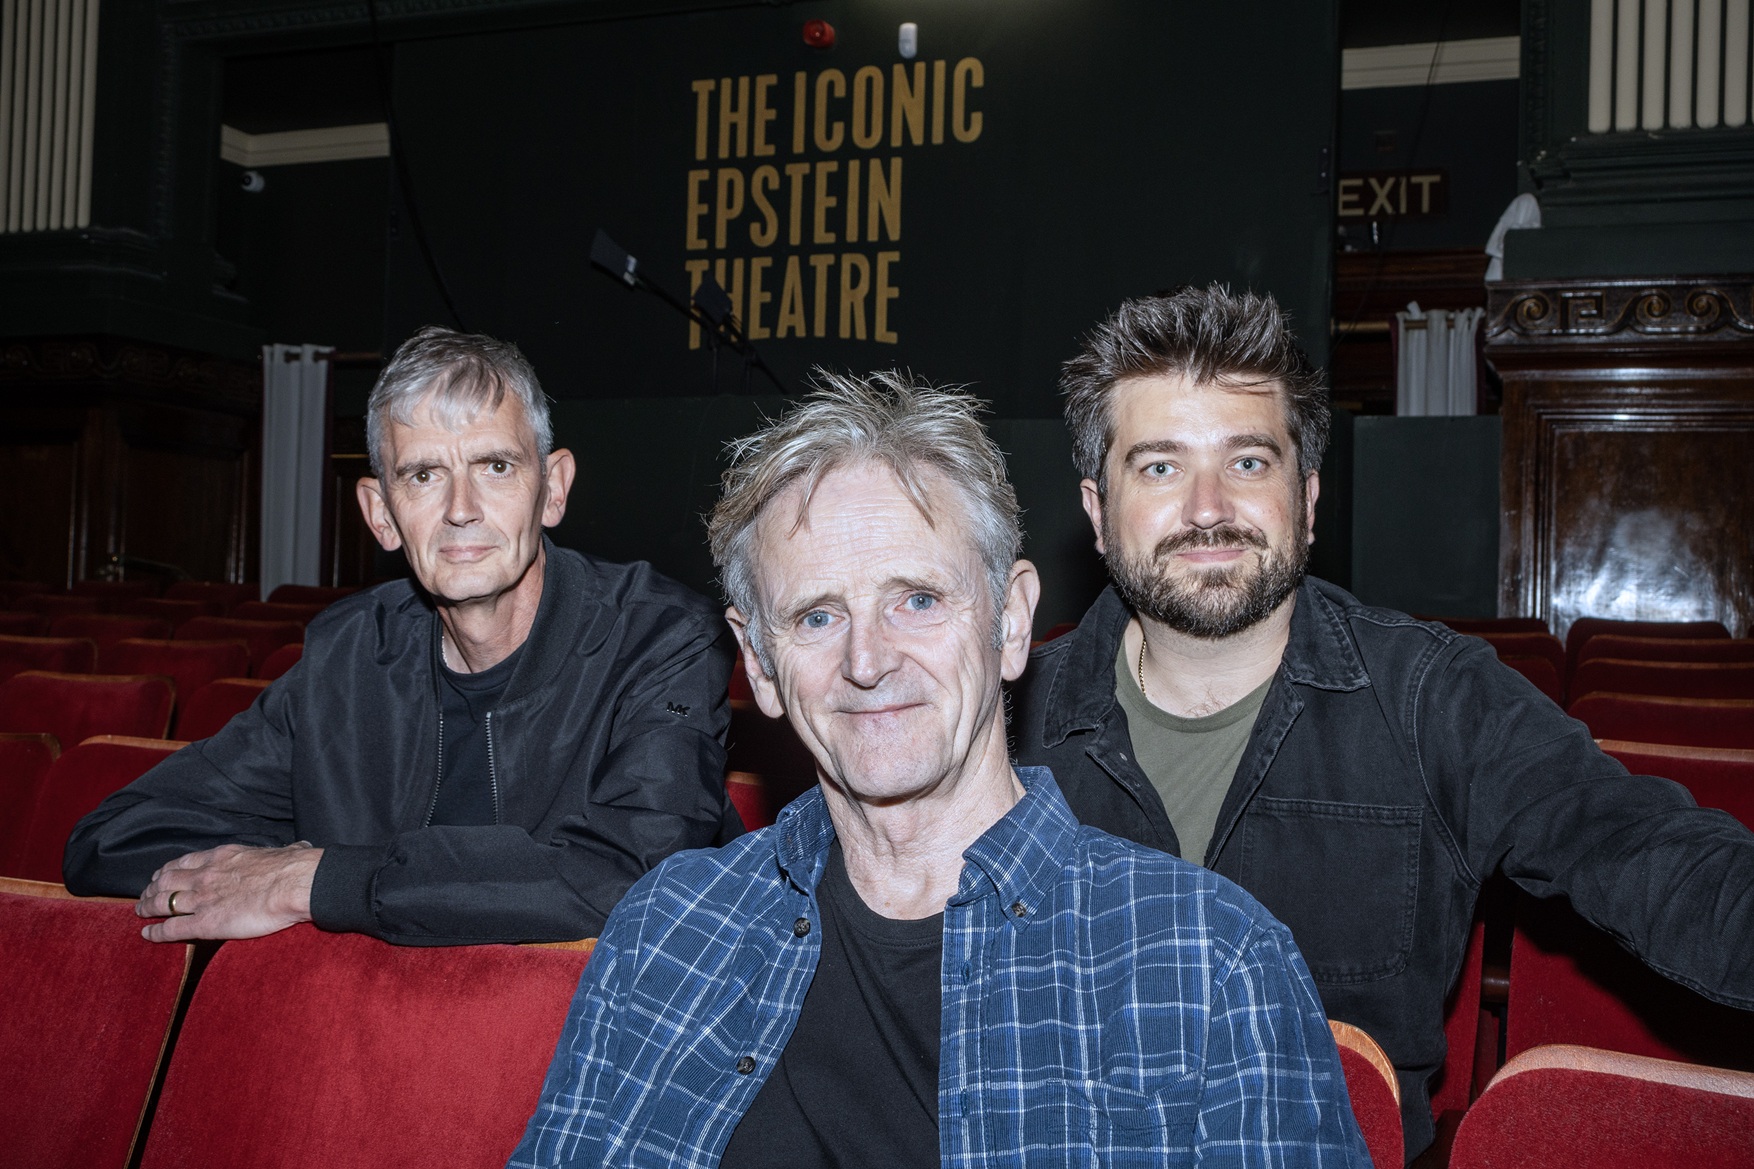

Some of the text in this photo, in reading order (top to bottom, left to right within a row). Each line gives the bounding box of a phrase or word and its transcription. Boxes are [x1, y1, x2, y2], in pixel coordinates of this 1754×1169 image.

[691, 57, 985, 161] THE ICONIC
[686, 156, 902, 251] EPSTEIN
[1338, 174, 1441, 217] EXIT
